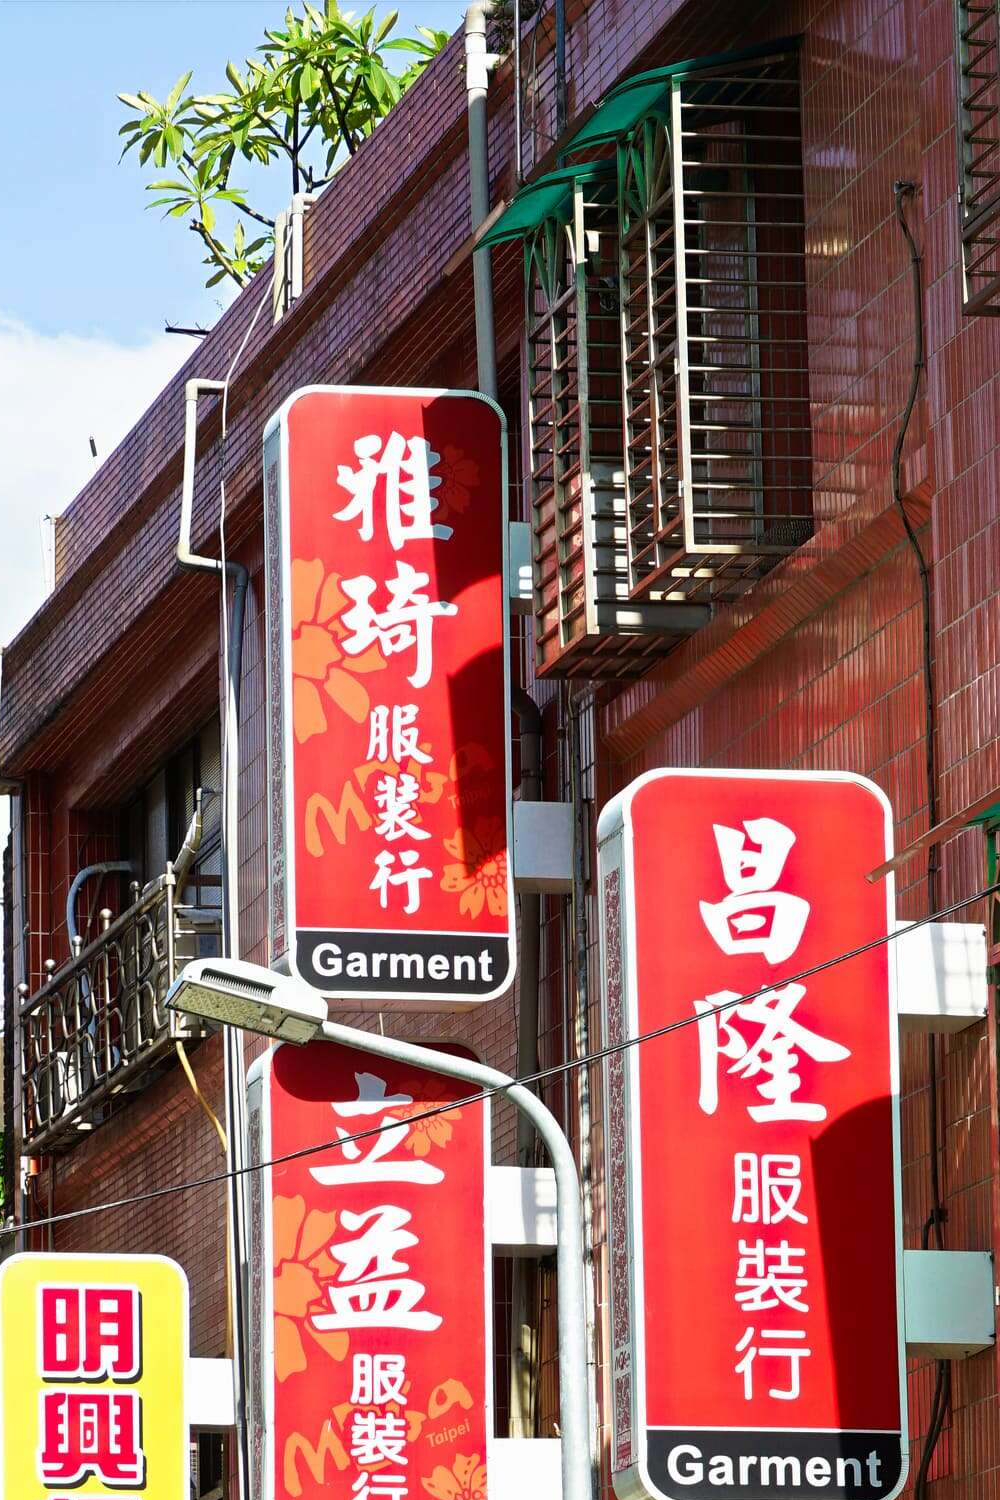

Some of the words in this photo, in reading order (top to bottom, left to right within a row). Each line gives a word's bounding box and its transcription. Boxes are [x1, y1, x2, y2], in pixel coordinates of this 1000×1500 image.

[331, 429, 457, 916] 雅琦服裝行
[312, 942, 493, 984] Garment
[695, 816, 851, 1402] 昌隆服裝行
[426, 1421, 472, 1448] Taipei
[667, 1444, 882, 1488] Garment
